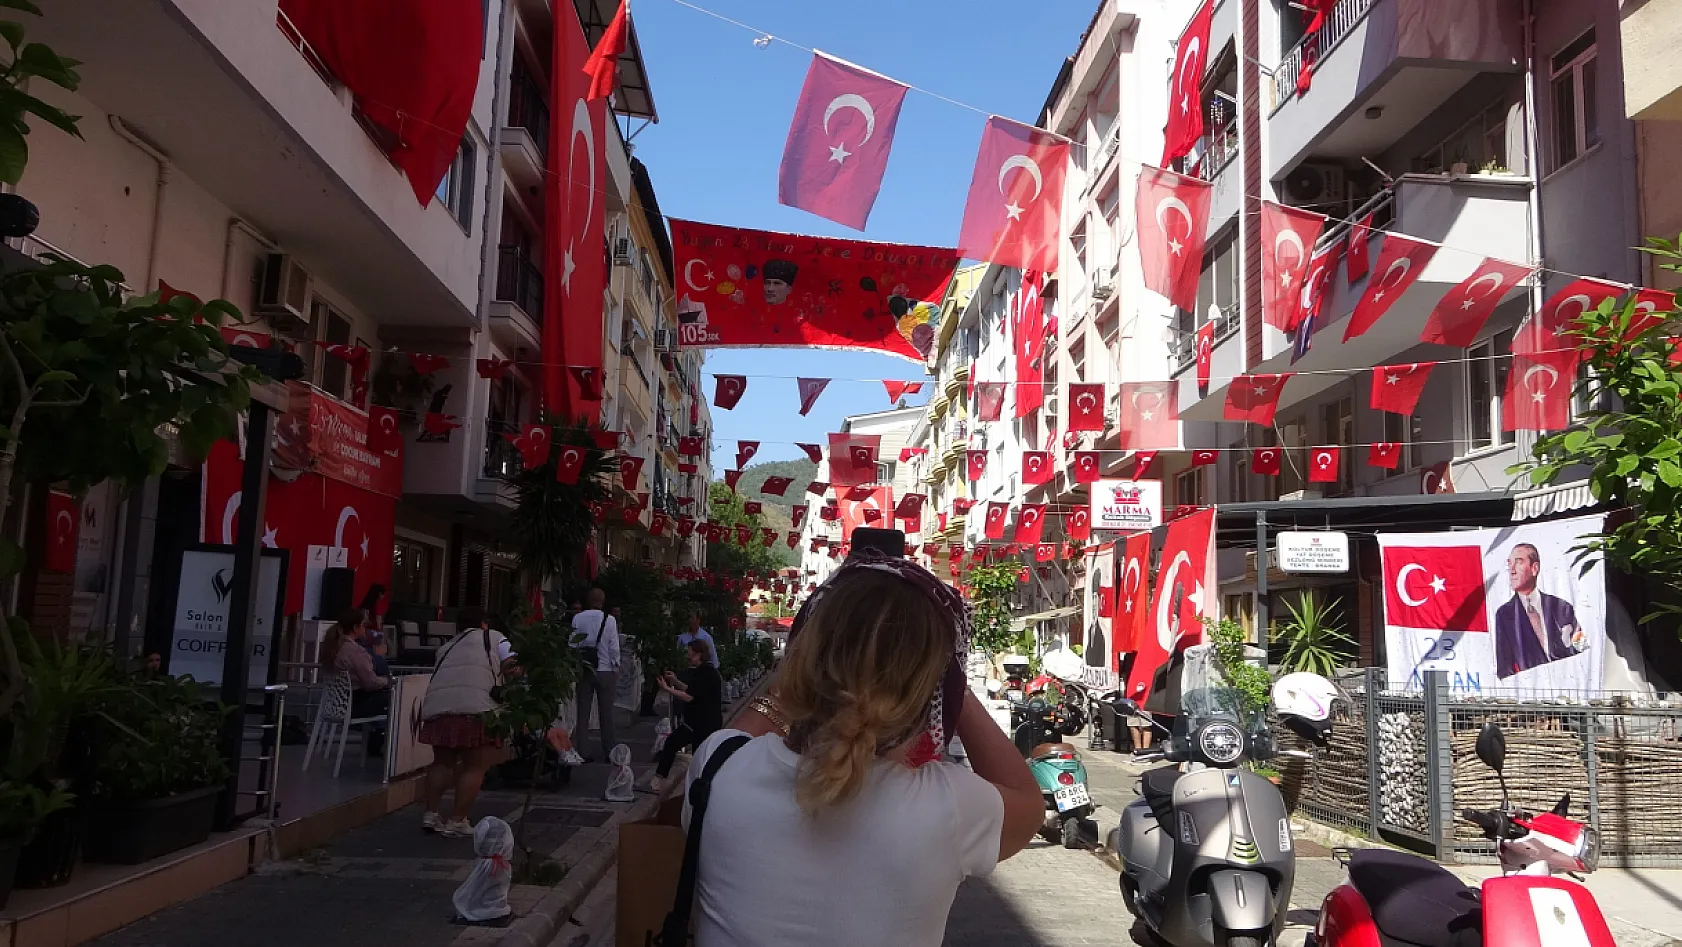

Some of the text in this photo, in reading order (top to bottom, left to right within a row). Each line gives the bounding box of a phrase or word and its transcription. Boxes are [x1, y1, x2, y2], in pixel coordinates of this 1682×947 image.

[680, 324, 708, 343] 105
[1103, 505, 1152, 515] MARMA
[186, 609, 223, 622] Salon
[177, 638, 266, 657] COIFFR
[1424, 637, 1456, 660] 23
[1413, 666, 1481, 692] NAN
